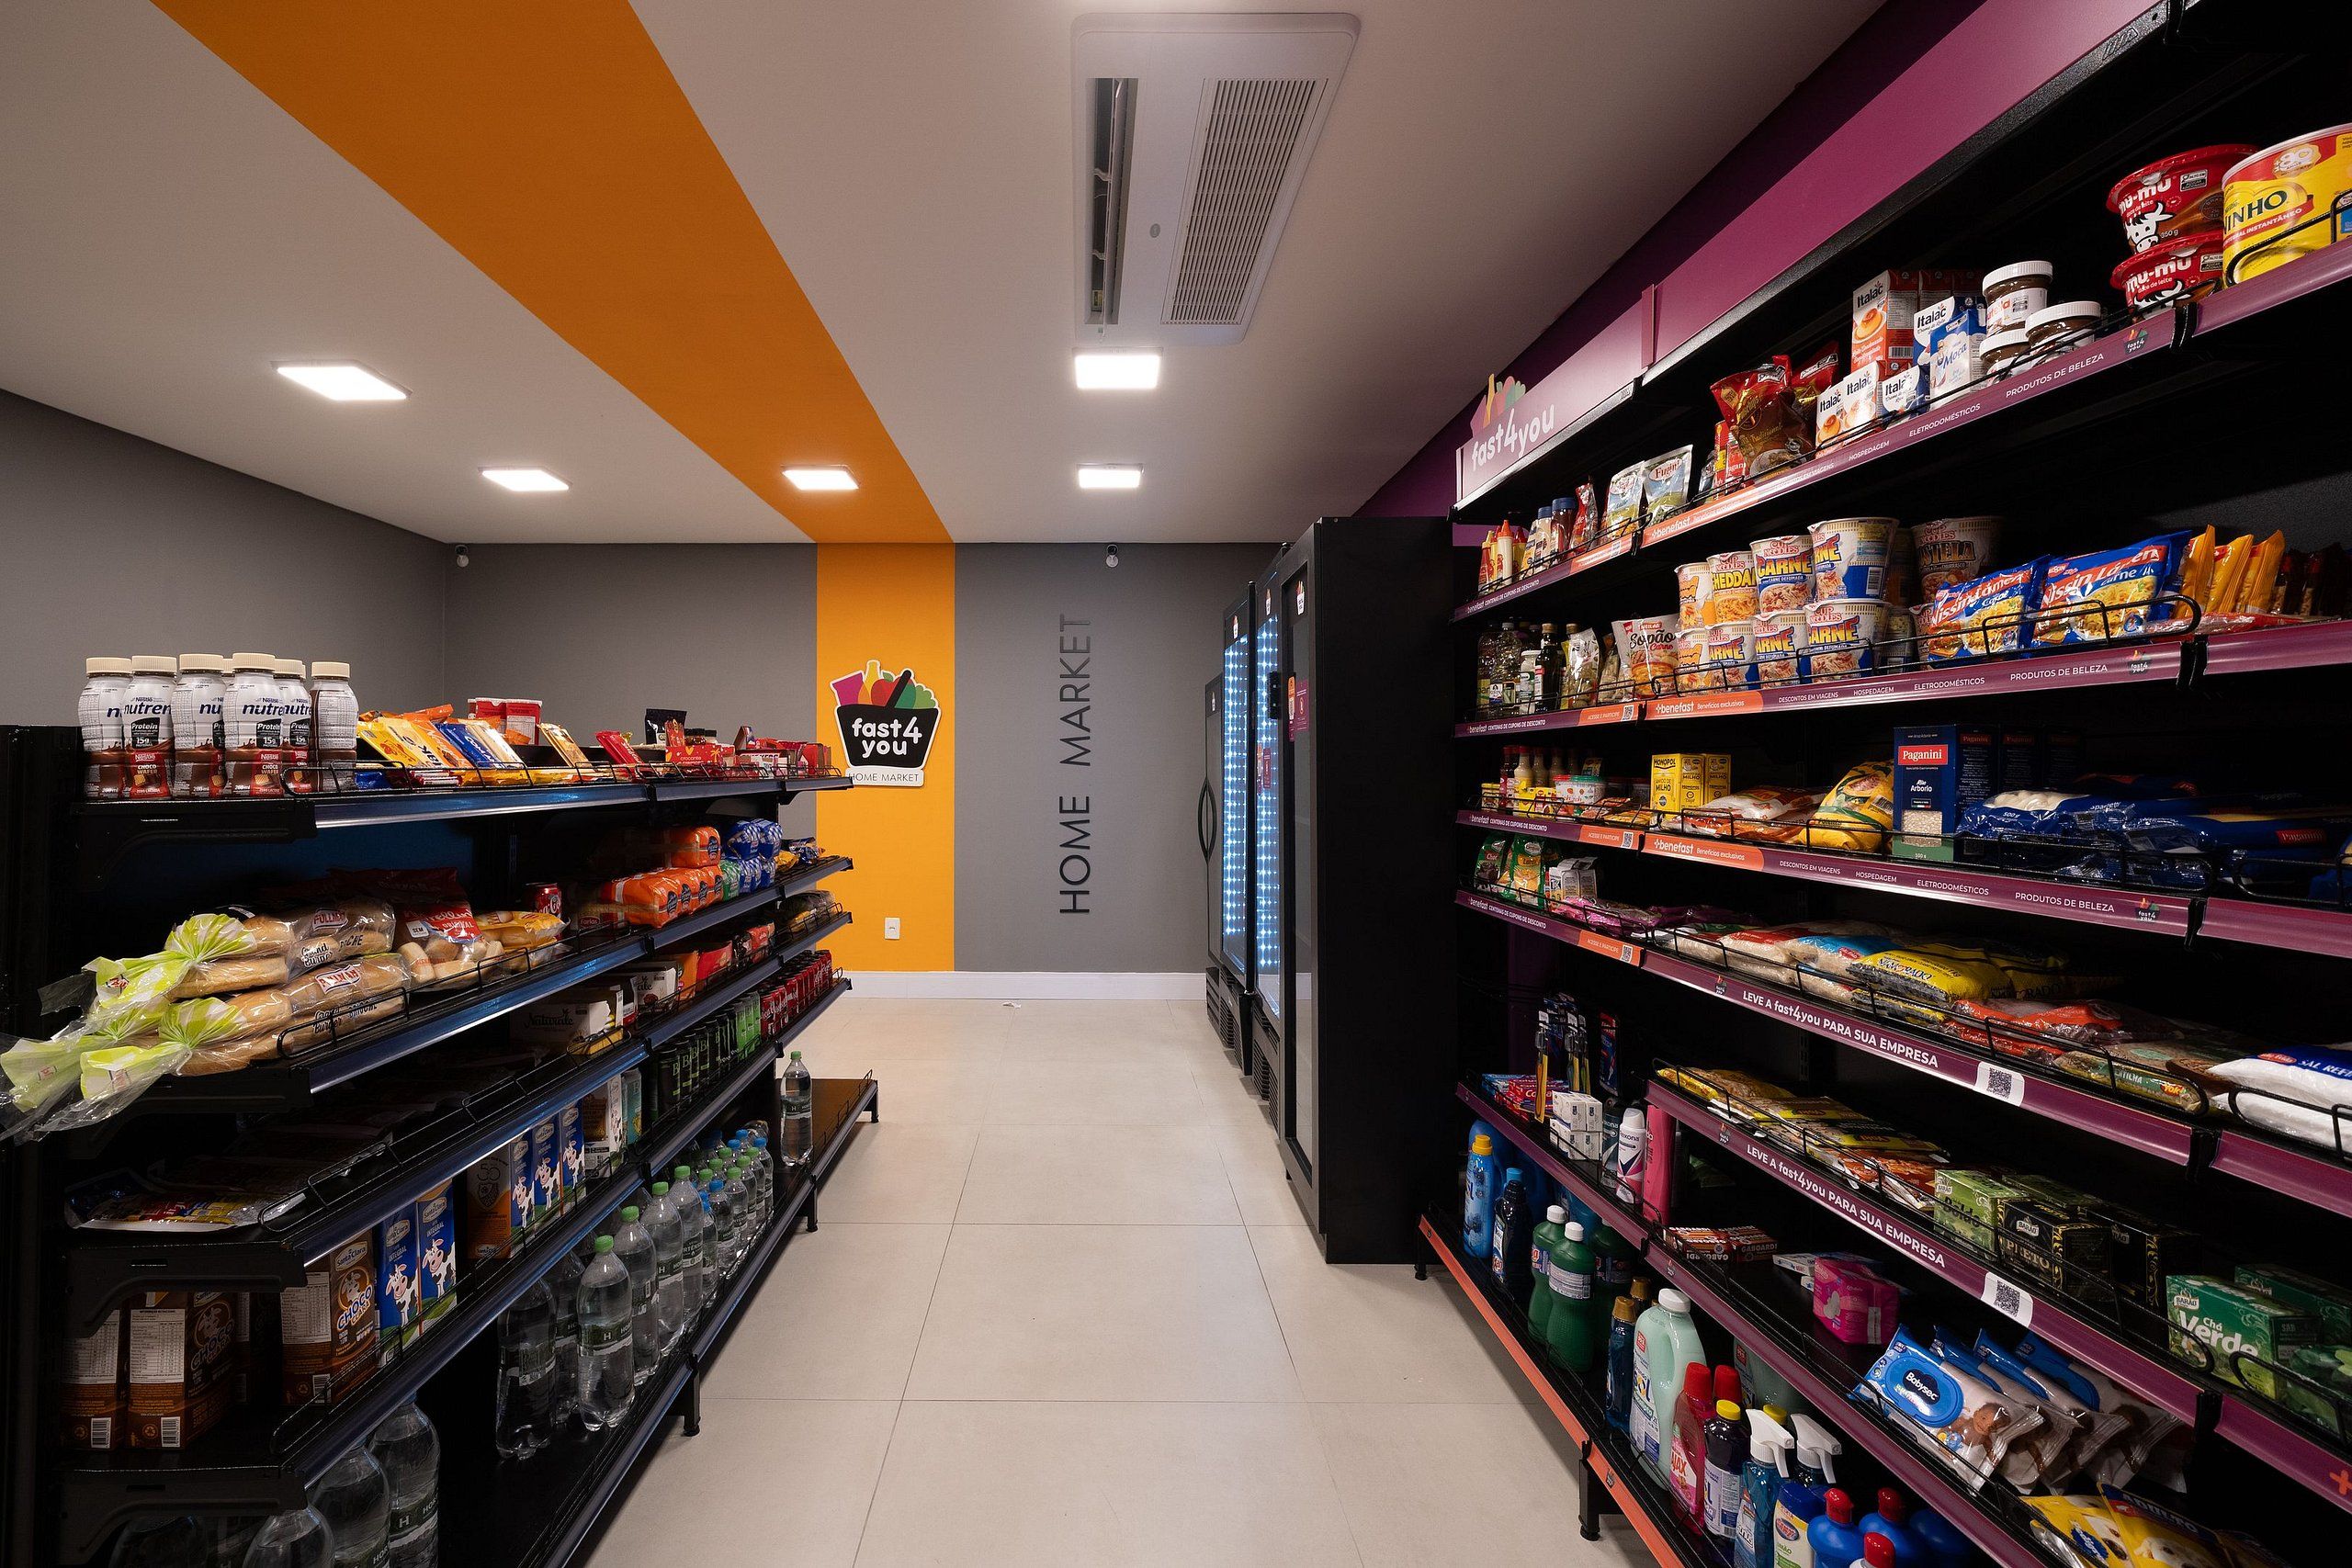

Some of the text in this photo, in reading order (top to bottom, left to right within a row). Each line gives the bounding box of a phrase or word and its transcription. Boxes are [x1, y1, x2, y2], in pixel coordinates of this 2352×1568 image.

[2246, 208, 2302, 234] INSTANTÂNEO
[1858, 285, 1883, 308] Italac
[1917, 308, 1947, 329] Italac
[1847, 374, 1871, 395] Italac
[2006, 353, 2105, 399] PRODUTOS DE BELEZA
[1820, 392, 1841, 413] Italac
[1909, 402, 1981, 438] ELETRODOMÉSTICOS
[1471, 404, 1555, 471] fast4you
[1849, 440, 1890, 462] HOSPEDAGEM
[1756, 551, 1814, 578] CARNE
[1521, 579, 1540, 592] DESCONTO
[1630, 630, 1676, 649] Sopão
[2010, 664, 2108, 681] PRODUTOS DE BELEZA
[1853, 686, 1894, 697] HOSPEDAGEM
[1914, 677, 1985, 691] ELETRODOMÉSTICOS
[1778, 691, 1838, 703] DESCONTOS EM VIAGENS
[1661, 700, 1745, 714] benefast Benefícios exclusivos
[131, 722, 159, 730] Protein
[852, 716, 922, 744] fast4
[1508, 721, 1521, 729] CUPONS
[1521, 720, 1526, 728] DE
[1526, 718, 1545, 728] DESCONTO
[136, 738, 150, 746] 15g
[263, 738, 276, 746] 15g
[862, 738, 908, 759] you
[1059, 614, 1091, 914] HOME MARKET
[1654, 758, 1676, 766] MONOPOL
[1903, 750, 1942, 761] Paganini
[849, 773, 919, 782] HOME MARKET
[1472, 814, 1489, 825] benefast
[1490, 818, 1505, 827] CENTENAS
[1510, 820, 1523, 829] CUPONS
[1529, 823, 1548, 832] DESCONTO
[1659, 840, 1745, 862] benefast Benefícios exclusivos
[1780, 860, 1840, 875] DESCONTOS EM VIAGENS
[1855, 871, 1897, 883] HOSPEDAGEM
[1917, 879, 1989, 896] ELETRODOMÉSTICOS
[2015, 892, 2114, 913] PRODUTOS DE BELEZA
[1470, 896, 1547, 929] benefast CENTENAS DE CUPONS DE DESCONTO
[1743, 991, 1939, 1068] LEVE A fast4you PARA SUA EMPRESA
[2298, 1058, 2321, 1071] SAL
[1747, 1144, 1946, 1269] LEVE A fast4you PARA SUA EMPRESA
[426, 1223, 445, 1238] INTEGRAL
[389, 1246, 407, 1261] INTEGRAL
[1741, 1244, 1778, 1254] GABOARDI
[337, 1285, 373, 1330] CHOCO
[2203, 1317, 2222, 1332] Chá
[604, 1333, 612, 1341] H
[2179, 1310, 2258, 1358] Verde
[1905, 1372, 1939, 1401] Babysec
[399, 1516, 410, 1528] H
